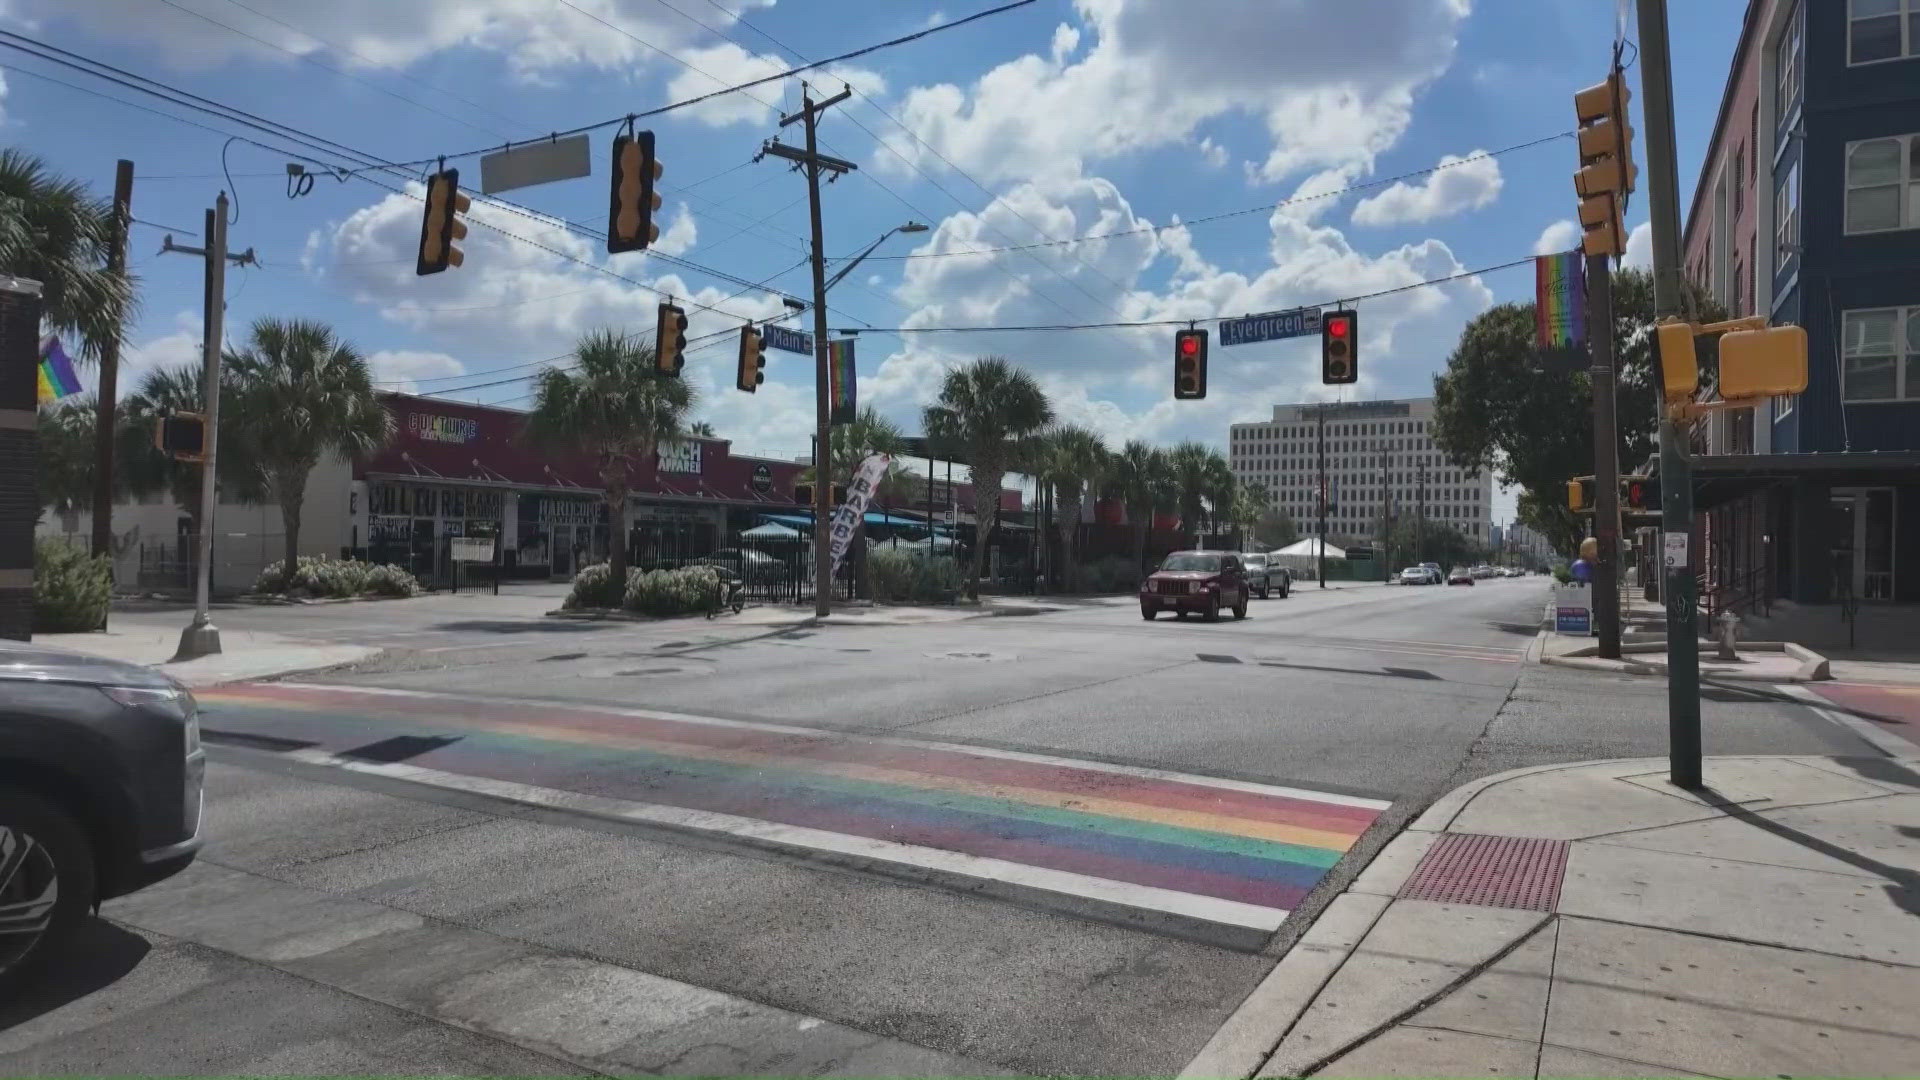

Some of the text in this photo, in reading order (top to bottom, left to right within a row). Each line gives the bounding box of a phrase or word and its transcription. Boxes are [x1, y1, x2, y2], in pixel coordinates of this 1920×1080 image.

[773, 329, 800, 350] Main
[1230, 315, 1302, 340] Evergreen
[408, 412, 477, 438] CULTURE
